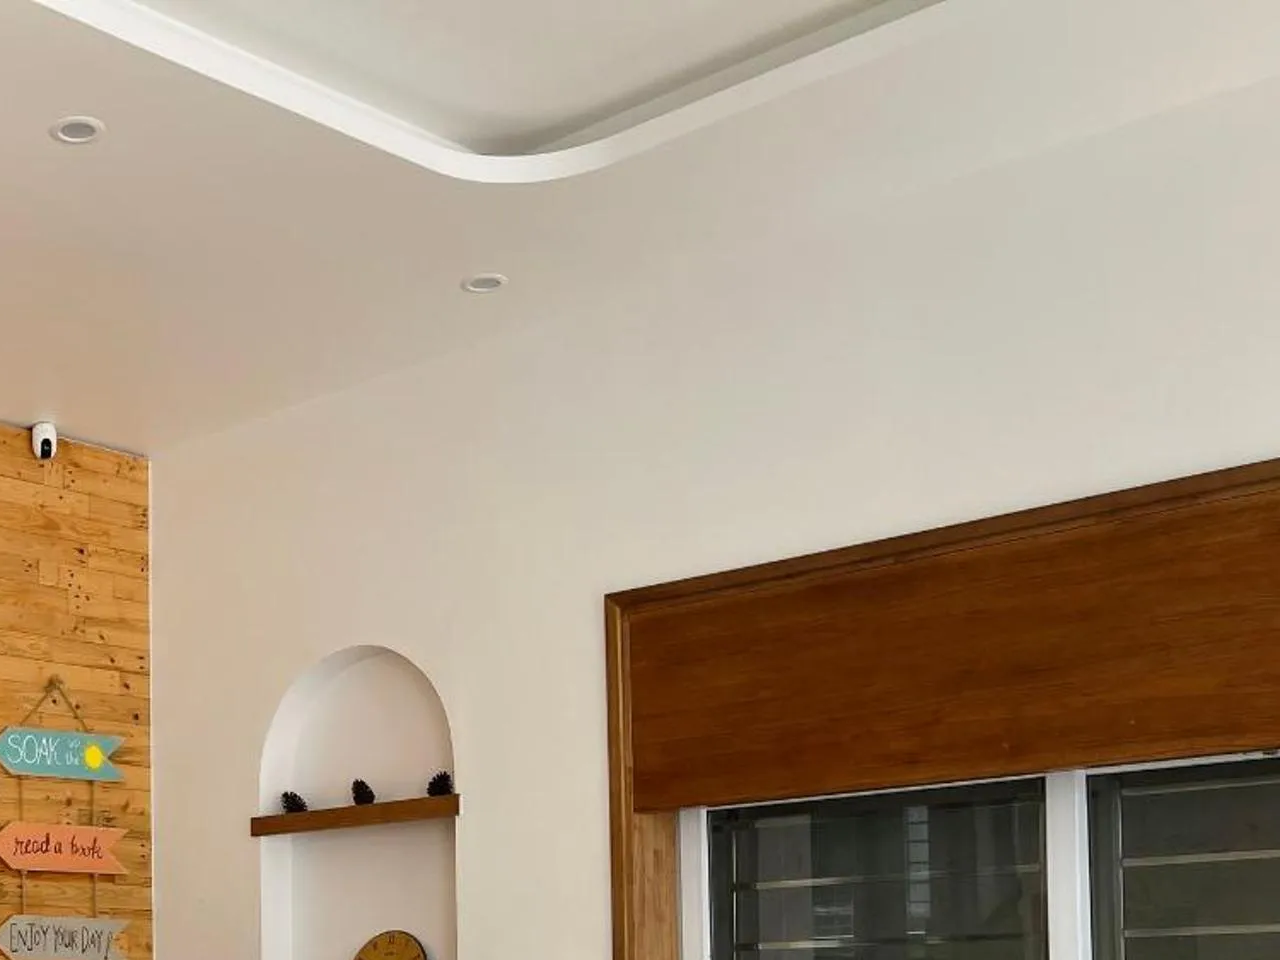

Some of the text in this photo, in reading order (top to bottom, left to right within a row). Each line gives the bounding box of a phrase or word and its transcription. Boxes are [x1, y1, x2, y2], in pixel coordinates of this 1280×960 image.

[6, 734, 61, 765] SOAK
[12, 832, 104, 859] read a book
[9, 923, 50, 953] ENJOY
[53, 924, 78, 953] YOUR
